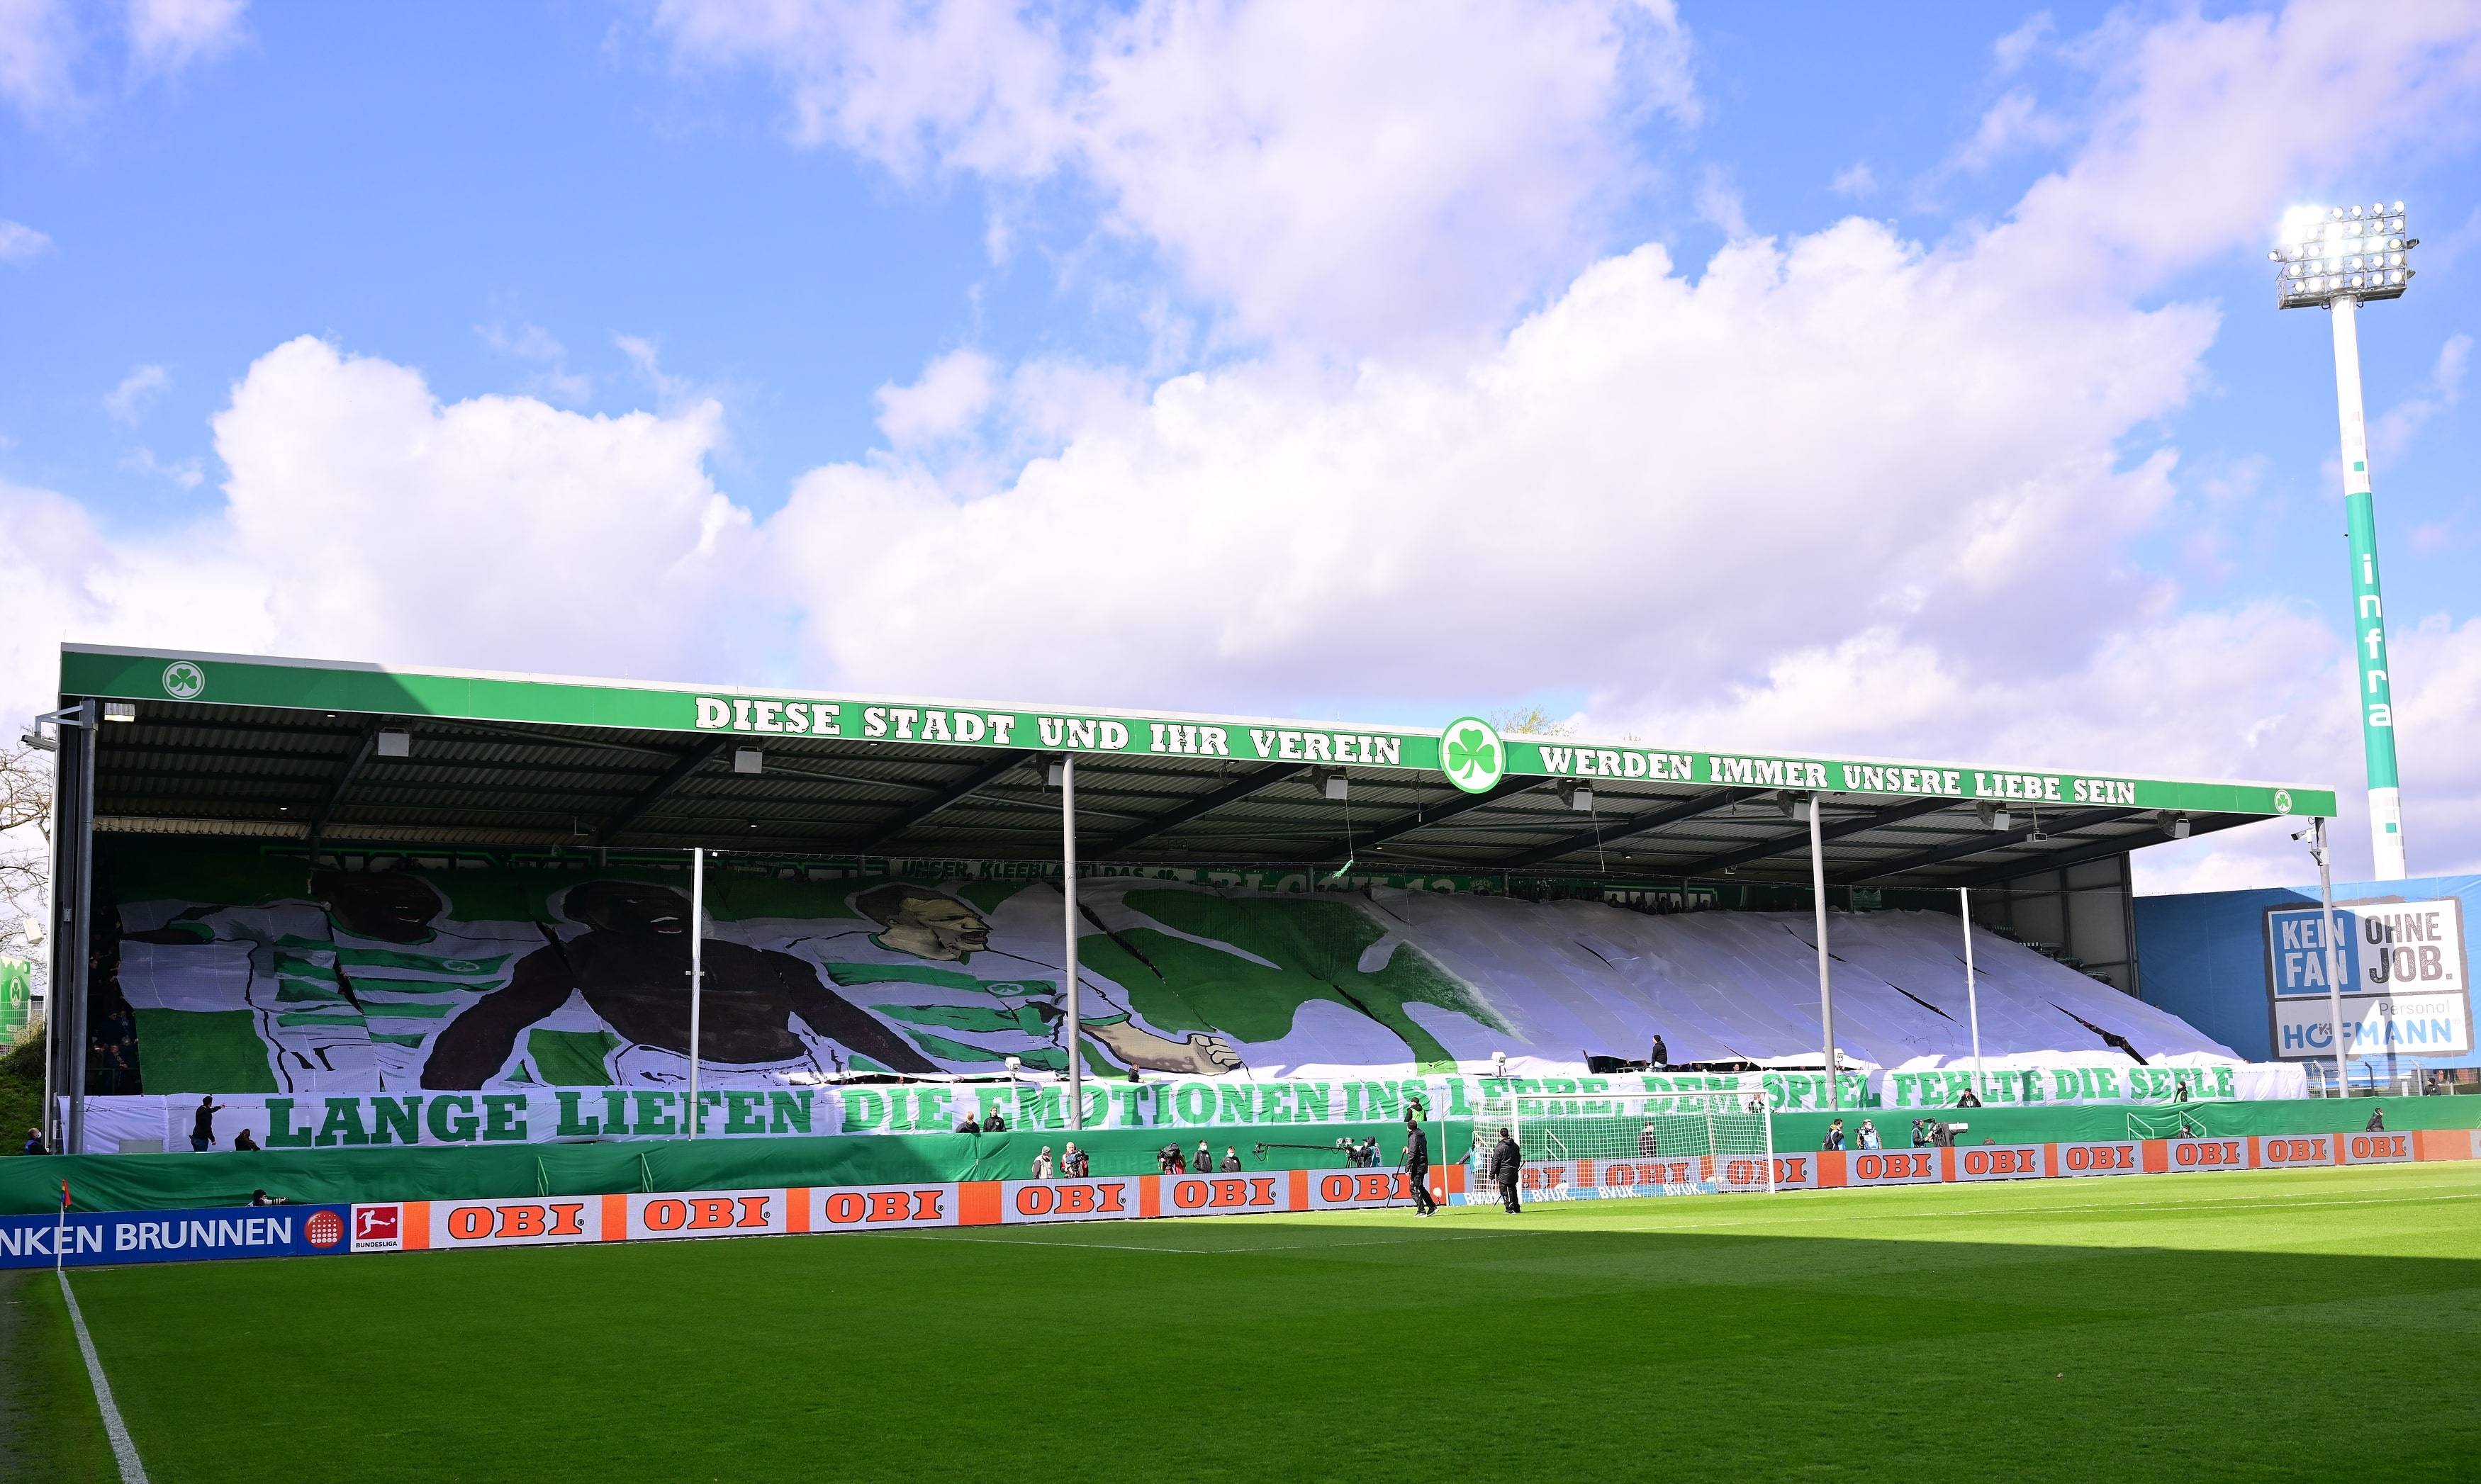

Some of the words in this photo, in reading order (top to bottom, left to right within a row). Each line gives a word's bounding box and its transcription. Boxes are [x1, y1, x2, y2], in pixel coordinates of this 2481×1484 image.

[2359, 553, 2392, 727] infra
[695, 696, 841, 736] DIESE
[863, 707, 1015, 746] STADT
[1038, 716, 1129, 751] UND
[1150, 722, 1230, 757] IHR
[1249, 729, 1401, 765] VEREIN
[1538, 746, 1693, 780] WERDEN
[1708, 755, 1828, 789] IMMER
[1843, 765, 1962, 796] UNSERE
[1974, 772, 2061, 802] LIEBE
[2073, 778, 2136, 805] SEIN
[979, 862, 1090, 878] KLEEBLAT
[2283, 918, 2345, 950] KEIN
[2365, 912, 2442, 945] OHNE
[2285, 950, 2348, 987] FAN
[2369, 945, 2453, 984] JOB.
[2380, 999, 2450, 1016] Personal
[265, 1094, 527, 1147] LANGE
[555, 1089, 814, 1136] LIEFEN
[841, 1087, 952, 1133] DIE
[975, 1081, 1331, 1131] EMOTIONEN
[1343, 1079, 1430, 1121] INS
[1642, 1076, 1741, 1113] DEM
[1762, 1074, 1881, 1109] SPIEL
[1893, 1069, 2044, 1107] FEHLTE
[2050, 1068, 2120, 1100] DIE
[2129, 1067, 2235, 1099] SEELE
[1965, 1149, 2035, 1174] OBI
[2066, 1146, 2134, 1170] OBI
[2176, 1142, 2239, 1165] OBI
[2268, 1139, 2326, 1162] OBI
[2352, 1136, 2406, 1158] OBI
[1606, 1163, 1689, 1186] OBI
[1727, 1158, 1806, 1184] OBI
[1856, 1154, 1931, 1179] OBI
[826, 1190, 943, 1224] OBI
[1016, 1184, 1126, 1216] OBI
[1174, 1178, 1276, 1209] OBI
[447, 1203, 584, 1240] OBI
[643, 1196, 771, 1231] OBI
[116, 1218, 291, 1251] BRUNNEN
